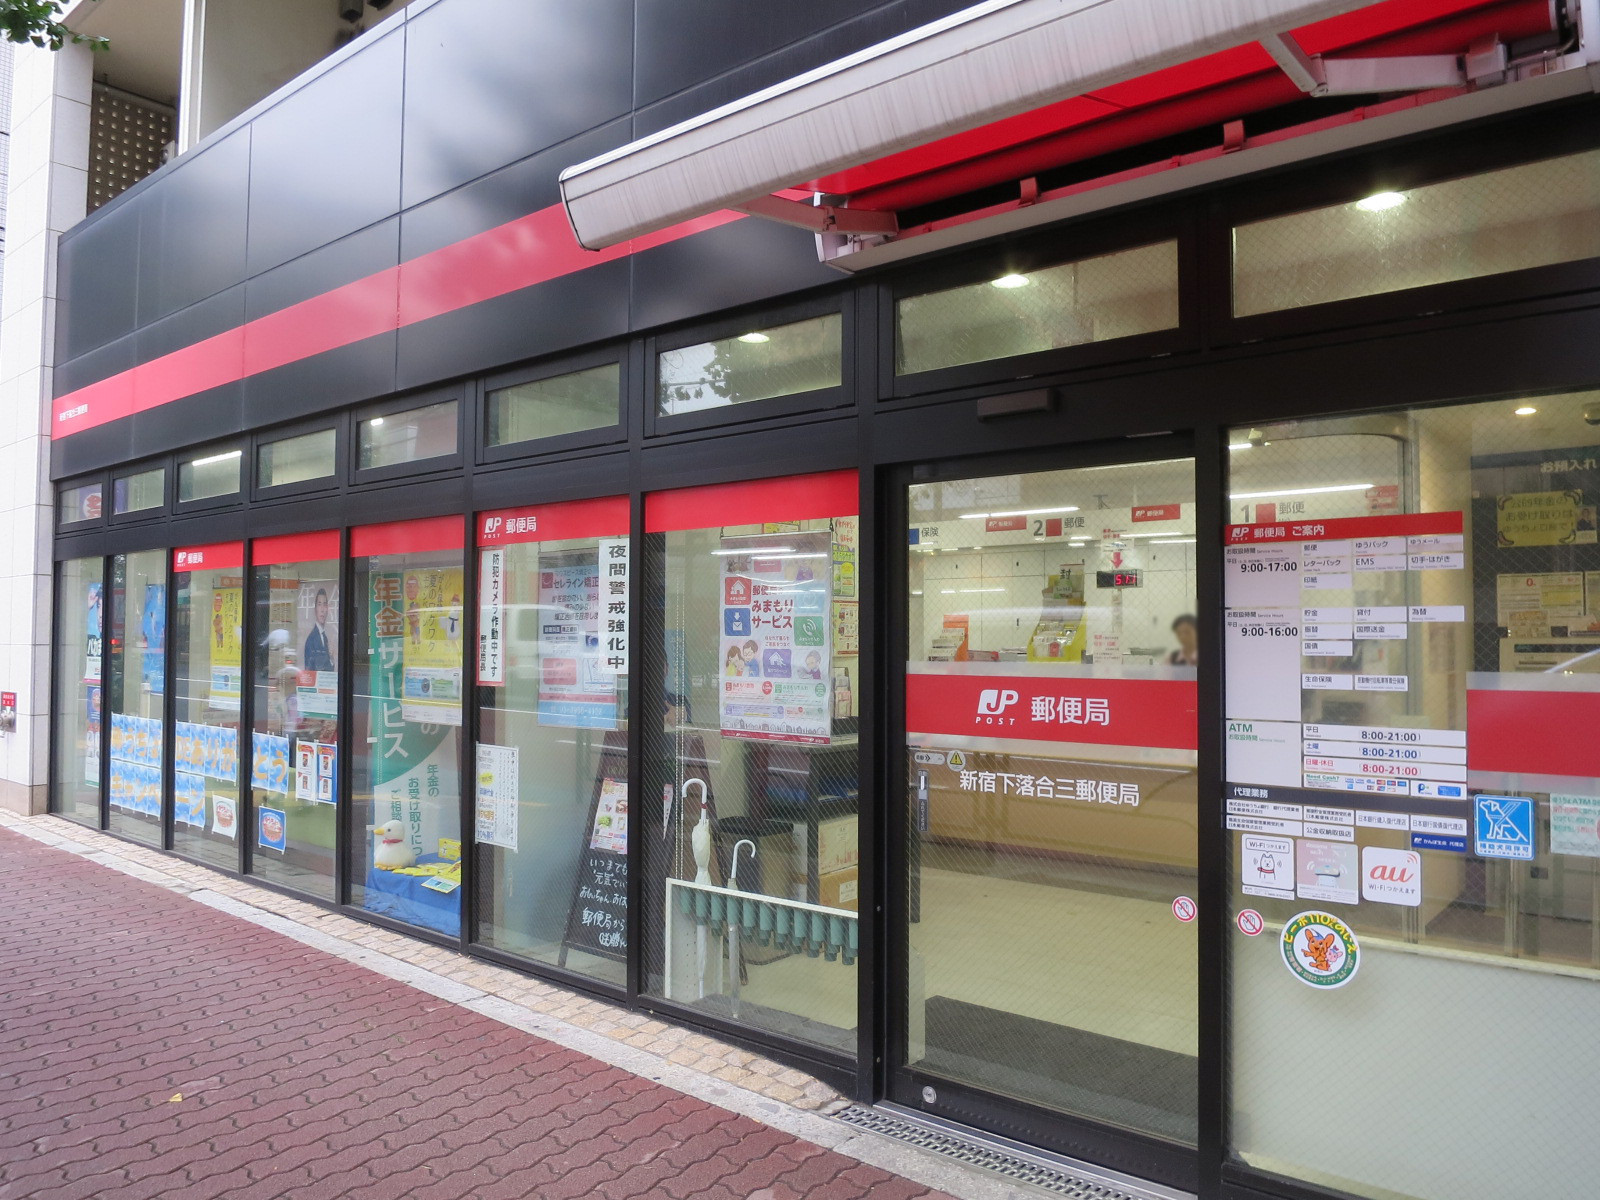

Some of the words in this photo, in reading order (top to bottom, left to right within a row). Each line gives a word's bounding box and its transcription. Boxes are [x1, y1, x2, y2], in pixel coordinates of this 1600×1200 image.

[1541, 458, 1597, 473] お預入れ
[1278, 501, 1305, 514] 郵便
[506, 516, 536, 534] 郵便局
[1033, 520, 1044, 536] 2
[1064, 516, 1085, 528] 郵便
[921, 527, 939, 538] 保険
[1254, 526, 1286, 538] 郵便局
[1292, 524, 1325, 536] ご案内
[1241, 562, 1298, 573] 9:00-17:00
[1356, 558, 1375, 566] EMS
[607, 544, 626, 670] 夜間警戒強化中
[752, 600, 793, 612] みまもり
[491, 553, 500, 677] 防犯カメラ作動中です
[752, 615, 792, 628] サービス
[1242, 627, 1298, 637] 9:00-16:00
[978, 690, 1019, 714] JP
[1031, 696, 1110, 726] 郵便局
[976, 716, 1016, 726] POST
[1229, 724, 1252, 732] ATM
[1362, 731, 1416, 741] 8:00-21:00
[1362, 748, 1418, 758] 8:00-21:00
[1362, 764, 1418, 775] 8:00-21:00
[427, 764, 440, 798] 年金の
[960, 770, 1140, 806] 新宿下落合三郵便局
[1234, 786, 1268, 798] 代理業務
[1229, 801, 1269, 809] 株式会社ゆうちょ銀行
[1306, 827, 1351, 837] 公金収納取扱店
[590, 858, 627, 875] いつまでも
[1370, 865, 1414, 882] au
[582, 907, 624, 931] 郵便局から
